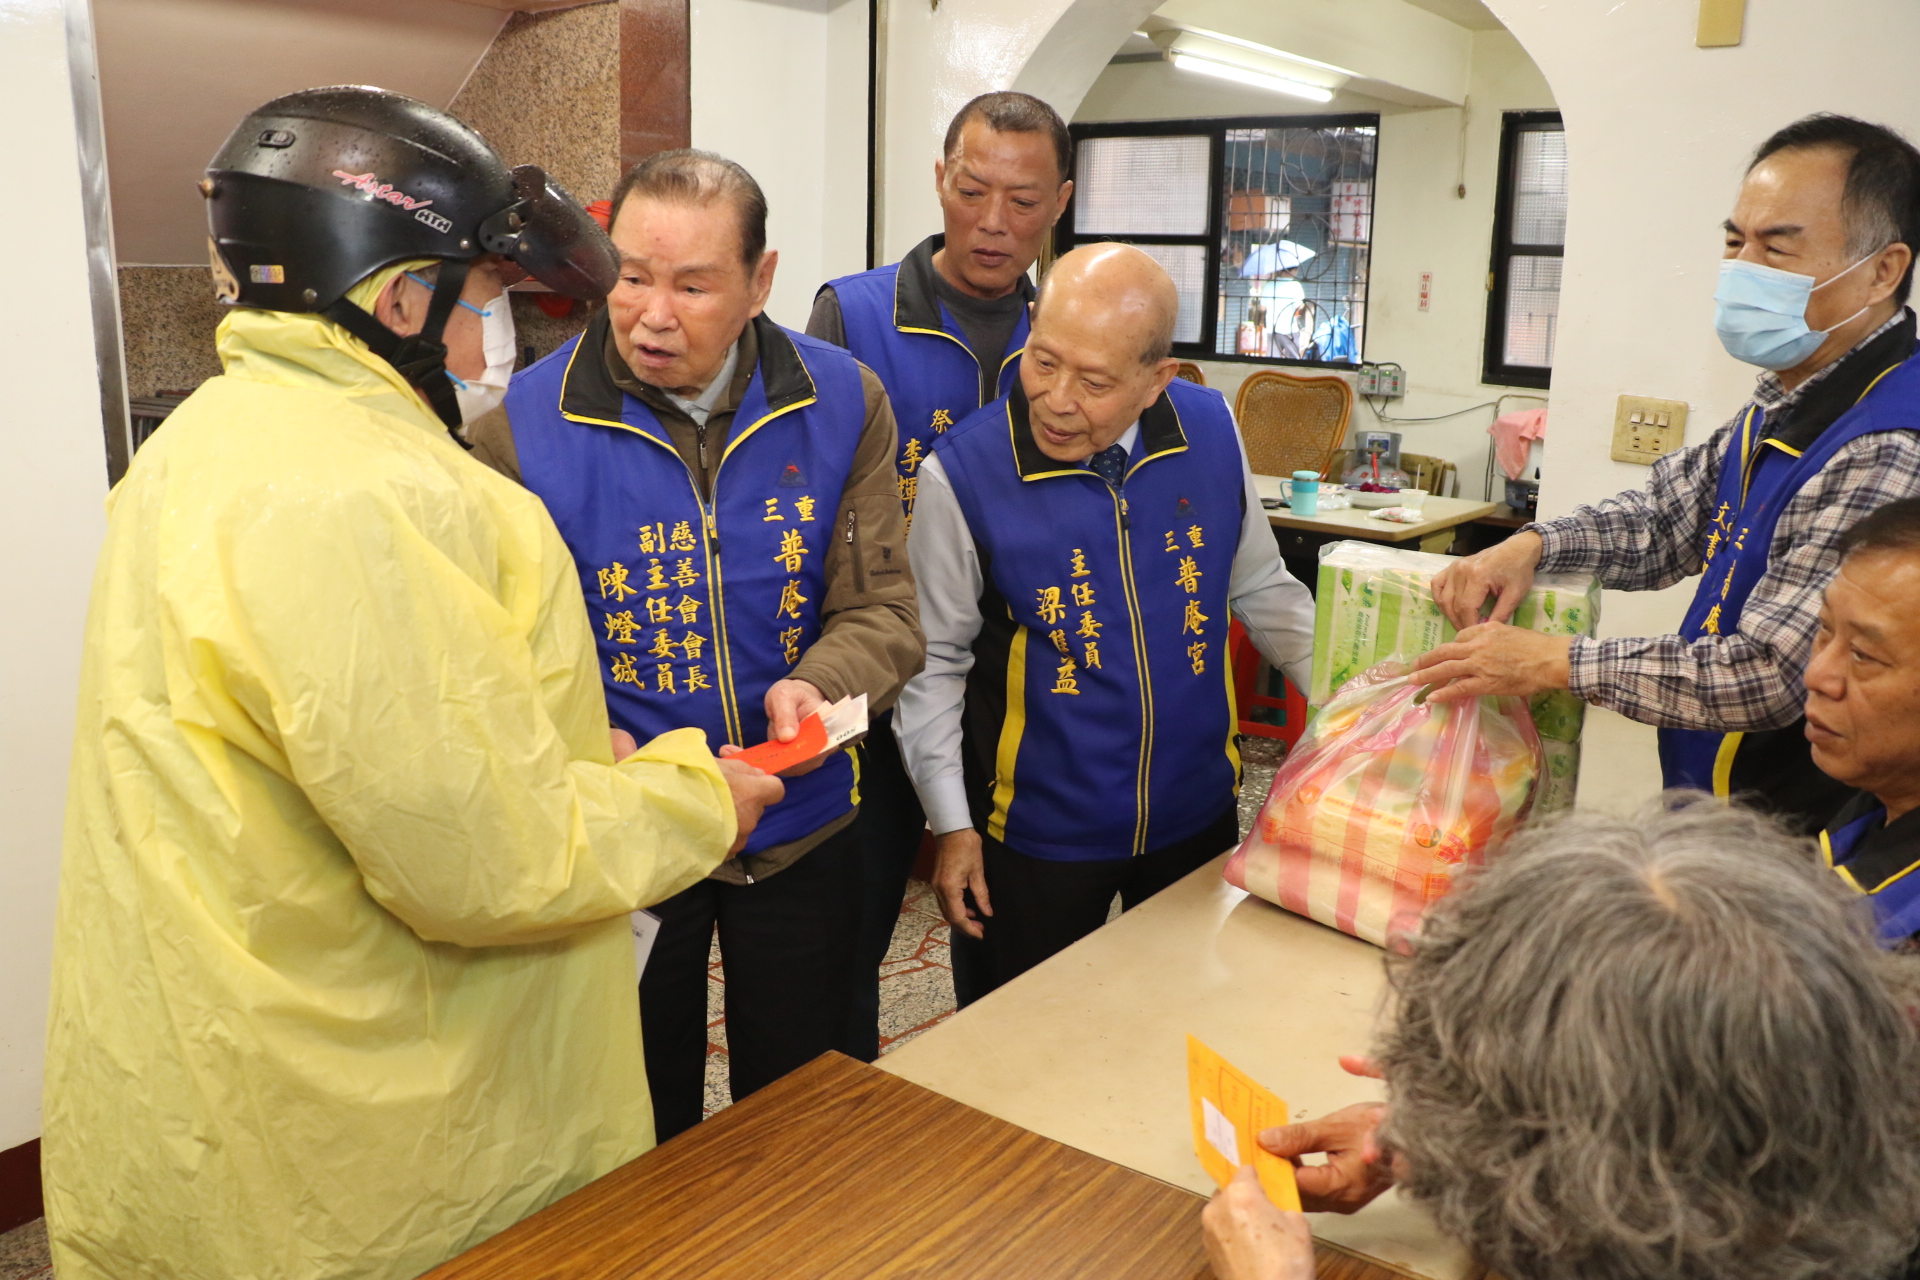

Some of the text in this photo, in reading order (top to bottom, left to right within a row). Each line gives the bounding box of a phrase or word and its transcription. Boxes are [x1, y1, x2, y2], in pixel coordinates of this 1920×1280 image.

[763, 495, 816, 522] 三重
[1165, 524, 1205, 552] 三重
[639, 522, 680, 695] 副主任委員
[669, 520, 713, 693] 慈善會會長
[773, 528, 809, 665] 普庵宮
[1070, 548, 1103, 669] 主任委員
[1175, 555, 1209, 675] 普庵宮
